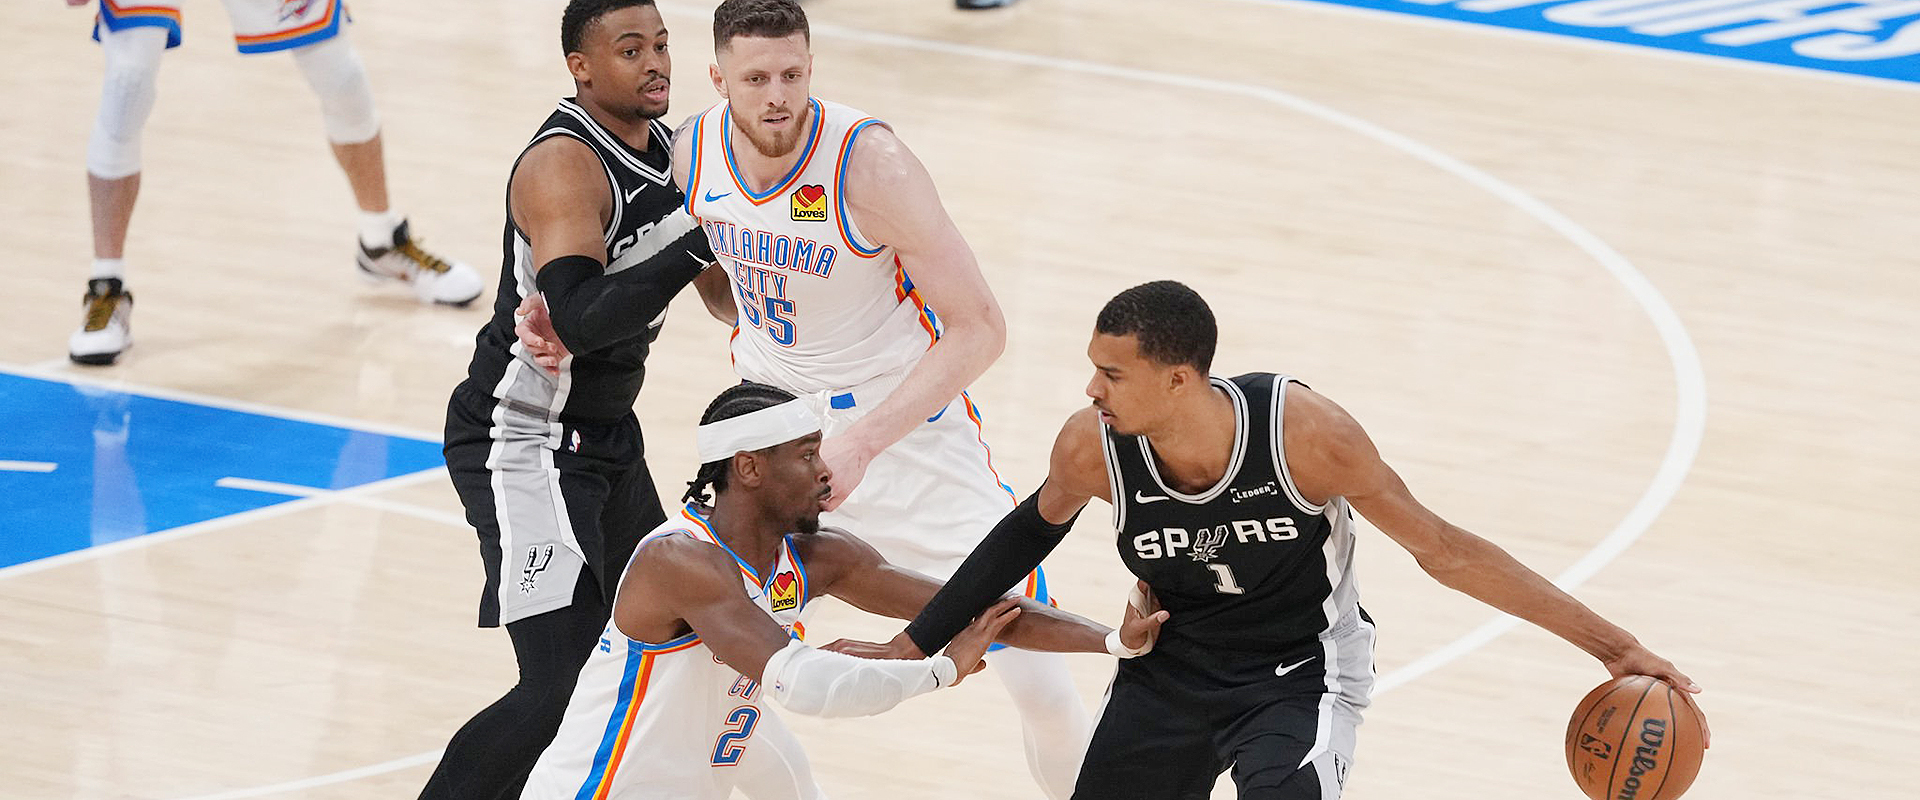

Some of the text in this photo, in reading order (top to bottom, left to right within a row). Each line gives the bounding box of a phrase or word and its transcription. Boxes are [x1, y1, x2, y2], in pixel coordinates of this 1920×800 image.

[794, 207, 825, 218] Love's
[706, 220, 838, 279] OKLAHOMA
[734, 261, 788, 300] CITY
[738, 283, 797, 348] 55
[1236, 485, 1272, 500] LEDGER
[1206, 563, 1246, 595] 1
[772, 594, 795, 609] Love's
[710, 704, 761, 767] 2
[1618, 718, 1666, 800] Wilson
